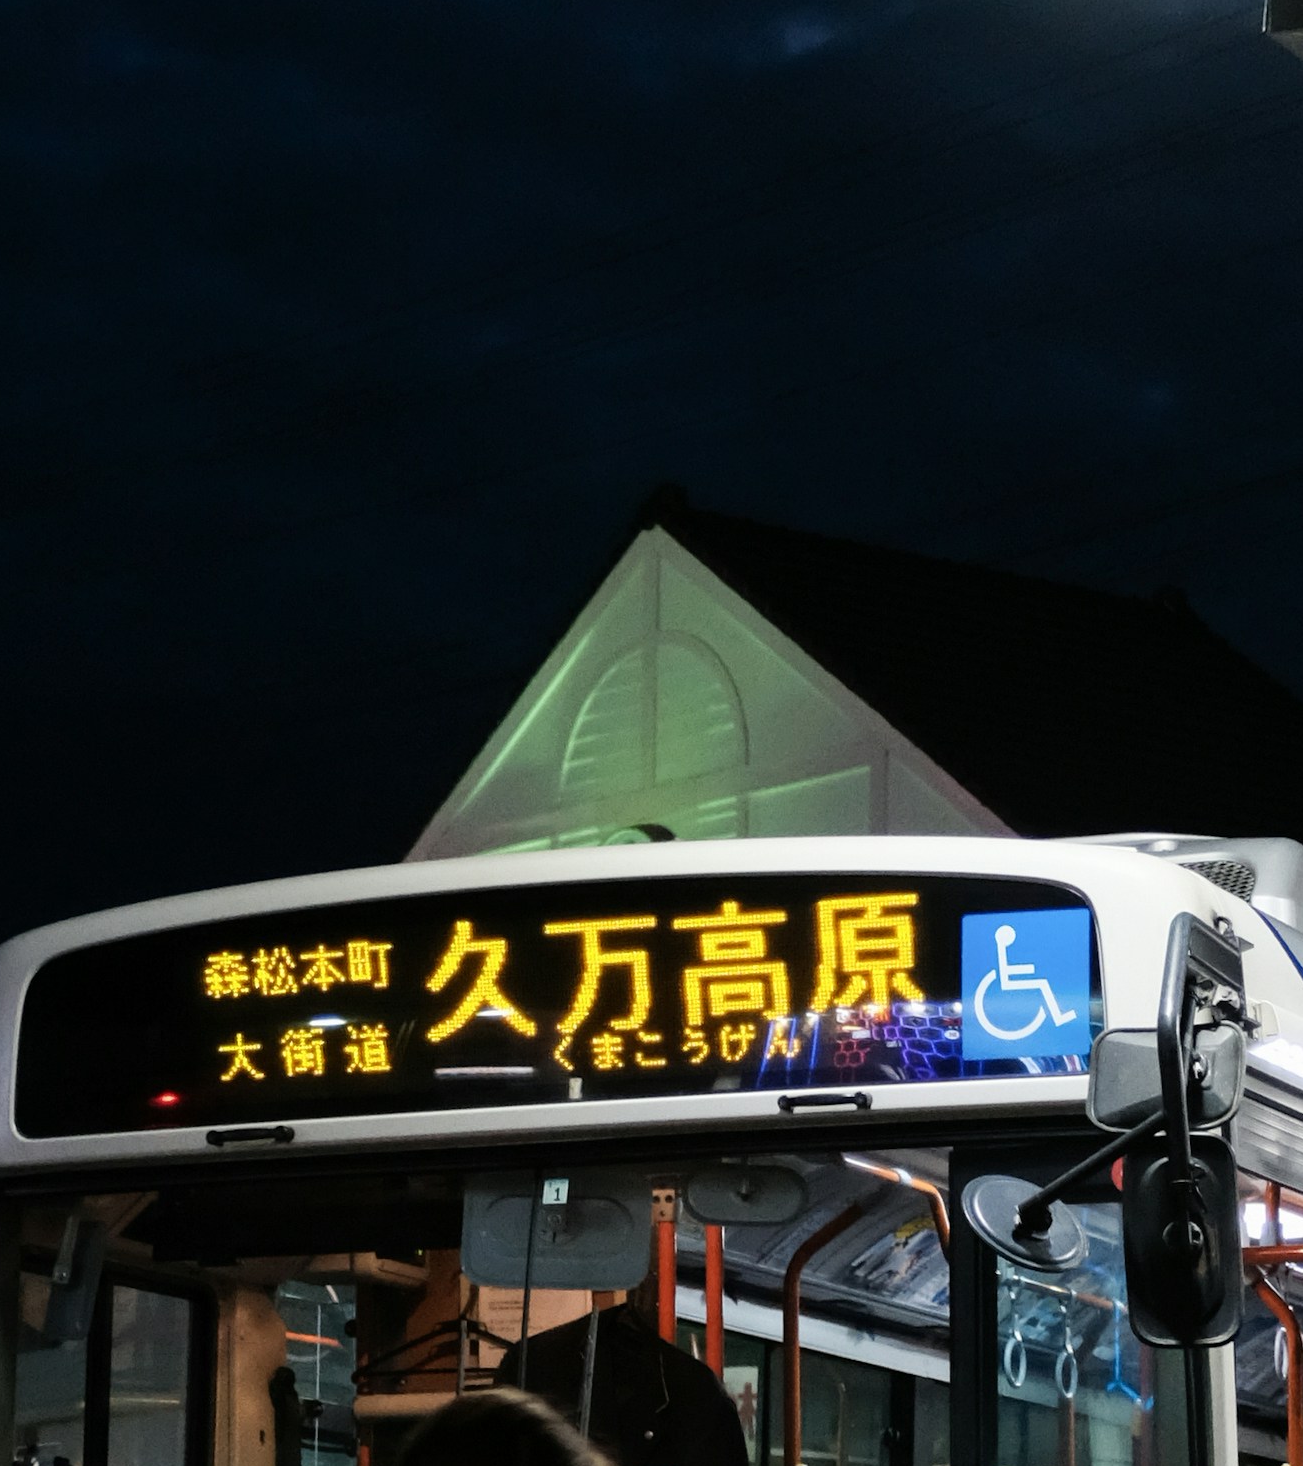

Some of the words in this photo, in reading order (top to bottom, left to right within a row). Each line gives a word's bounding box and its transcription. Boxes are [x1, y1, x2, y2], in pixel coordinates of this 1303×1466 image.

[204, 938, 393, 999] 森松本町
[426, 893, 925, 1043] 久万高原
[218, 1023, 392, 1081] 大街道
[552, 1023, 802, 1072] くまこうげん
